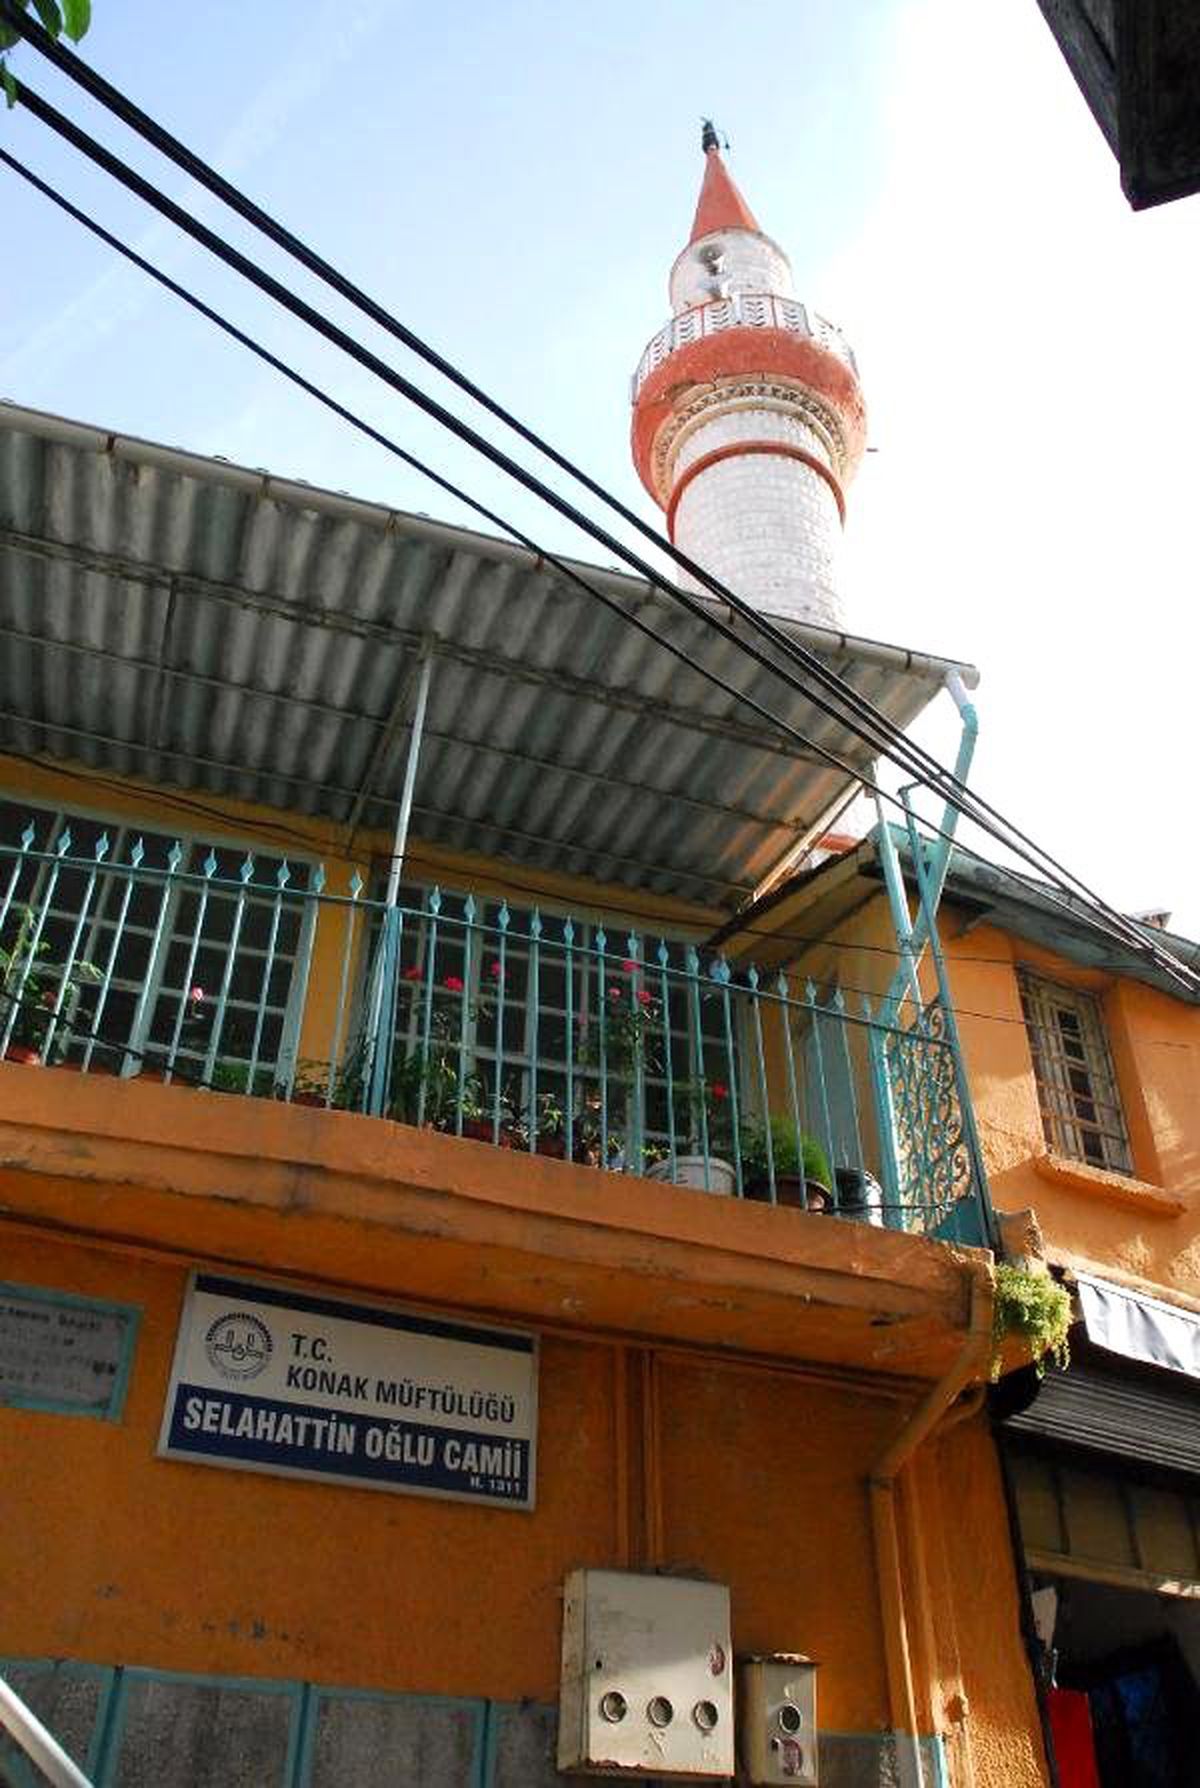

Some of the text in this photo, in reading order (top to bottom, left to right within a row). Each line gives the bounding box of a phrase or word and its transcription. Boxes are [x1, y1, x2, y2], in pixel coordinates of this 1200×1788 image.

[291, 1333, 333, 1363] T.C.
[286, 1365, 516, 1424] KONAK MÜFTÜLÜĞÜ
[183, 1396, 522, 1479] SELAHATTİN OĞLU CAMİİ
